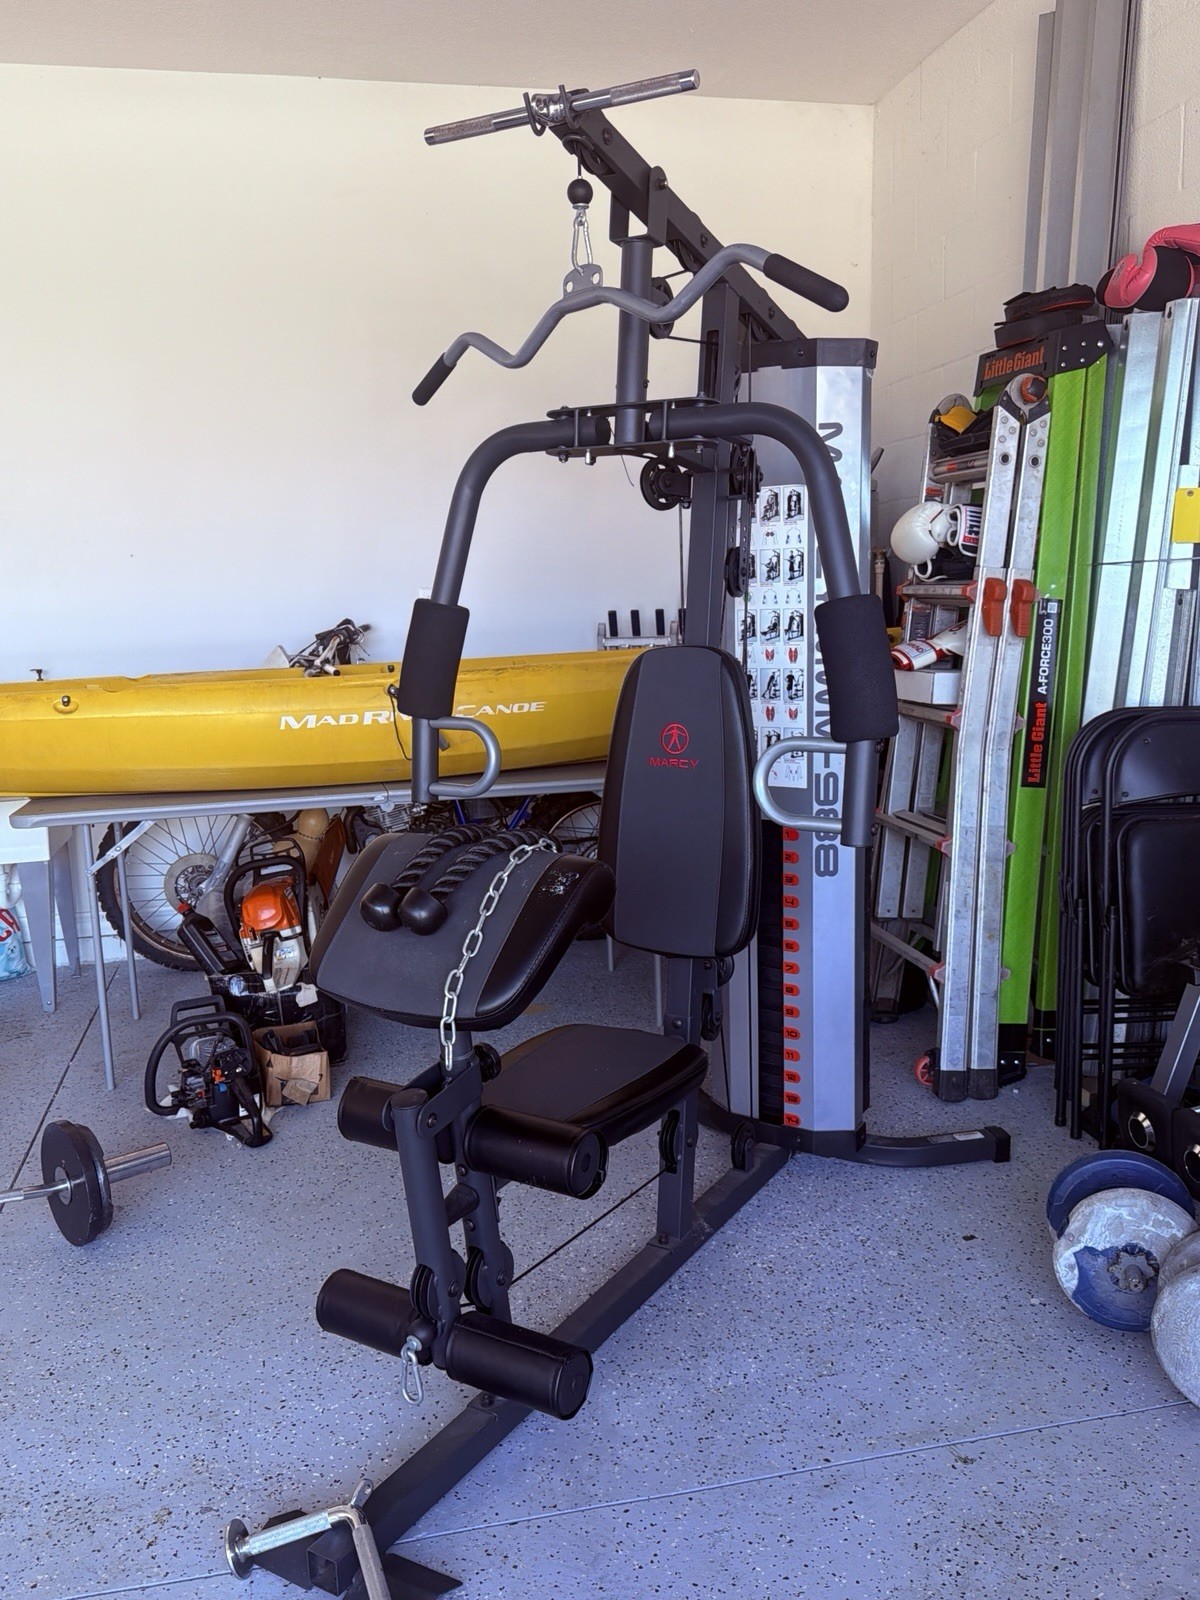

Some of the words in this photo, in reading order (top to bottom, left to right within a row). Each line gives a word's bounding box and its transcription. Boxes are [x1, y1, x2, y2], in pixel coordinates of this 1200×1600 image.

[983, 357, 1012, 380] Little
[1014, 346, 1045, 372] Giant
[1037, 618, 1055, 695] A-FORCE300
[1031, 702, 1047, 742] Giant
[648, 757, 699, 769] MARCY
[1027, 744, 1044, 783] Little
